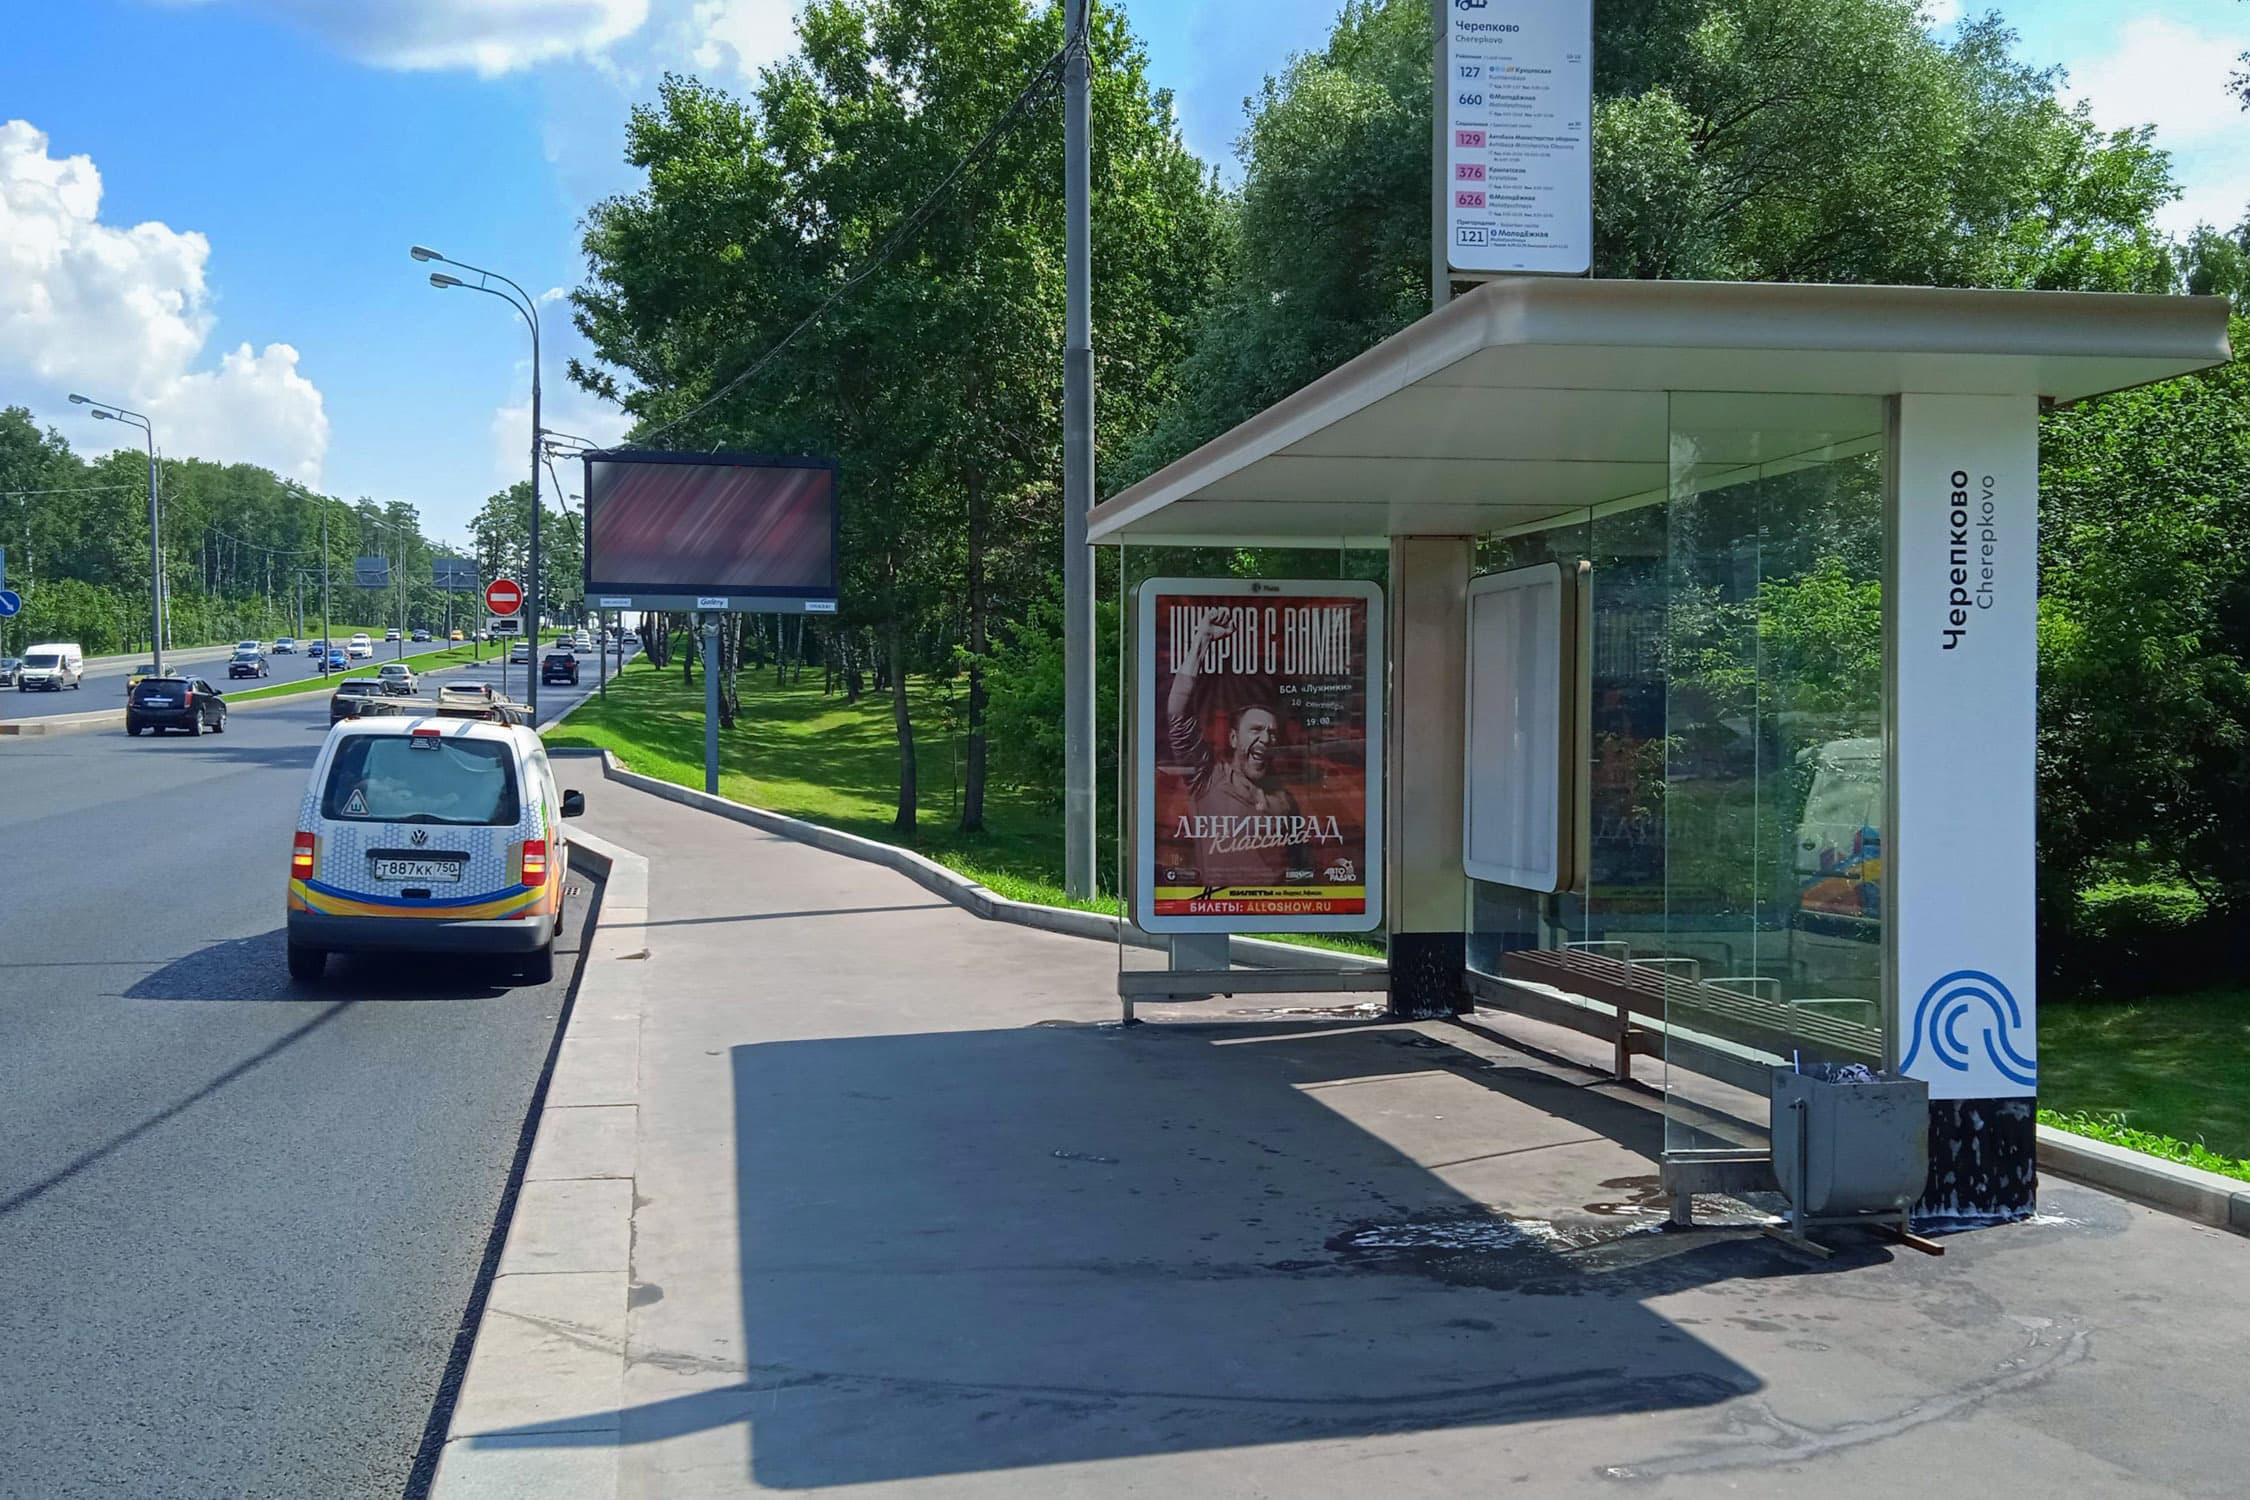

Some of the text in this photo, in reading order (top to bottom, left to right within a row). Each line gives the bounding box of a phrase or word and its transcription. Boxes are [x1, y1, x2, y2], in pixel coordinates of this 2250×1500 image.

[1455, 20, 1520, 33] Черепково
[1455, 34, 1503, 45] Cherepkovo
[1460, 66, 1480, 78] 127
[1458, 94, 1482, 106] 660
[1460, 133, 1480, 145] 129
[1459, 167, 1482, 178] 376
[1459, 194, 1482, 206] 626
[1461, 230, 1484, 242] 121
[1976, 475, 1997, 610] Cherepkovo
[1943, 470, 1972, 650] Черепково
[1264, 607, 1276, 675] С
[1284, 607, 1351, 675] ВАМИ!
[1279, 685, 1297, 694] БСА
[1173, 815, 1343, 845] ЛЕНИНГРАД
[1209, 831, 1310, 855] Классика
[1189, 902, 1332, 913] БИЛЕТЫ: ALLOSHOW.RU
